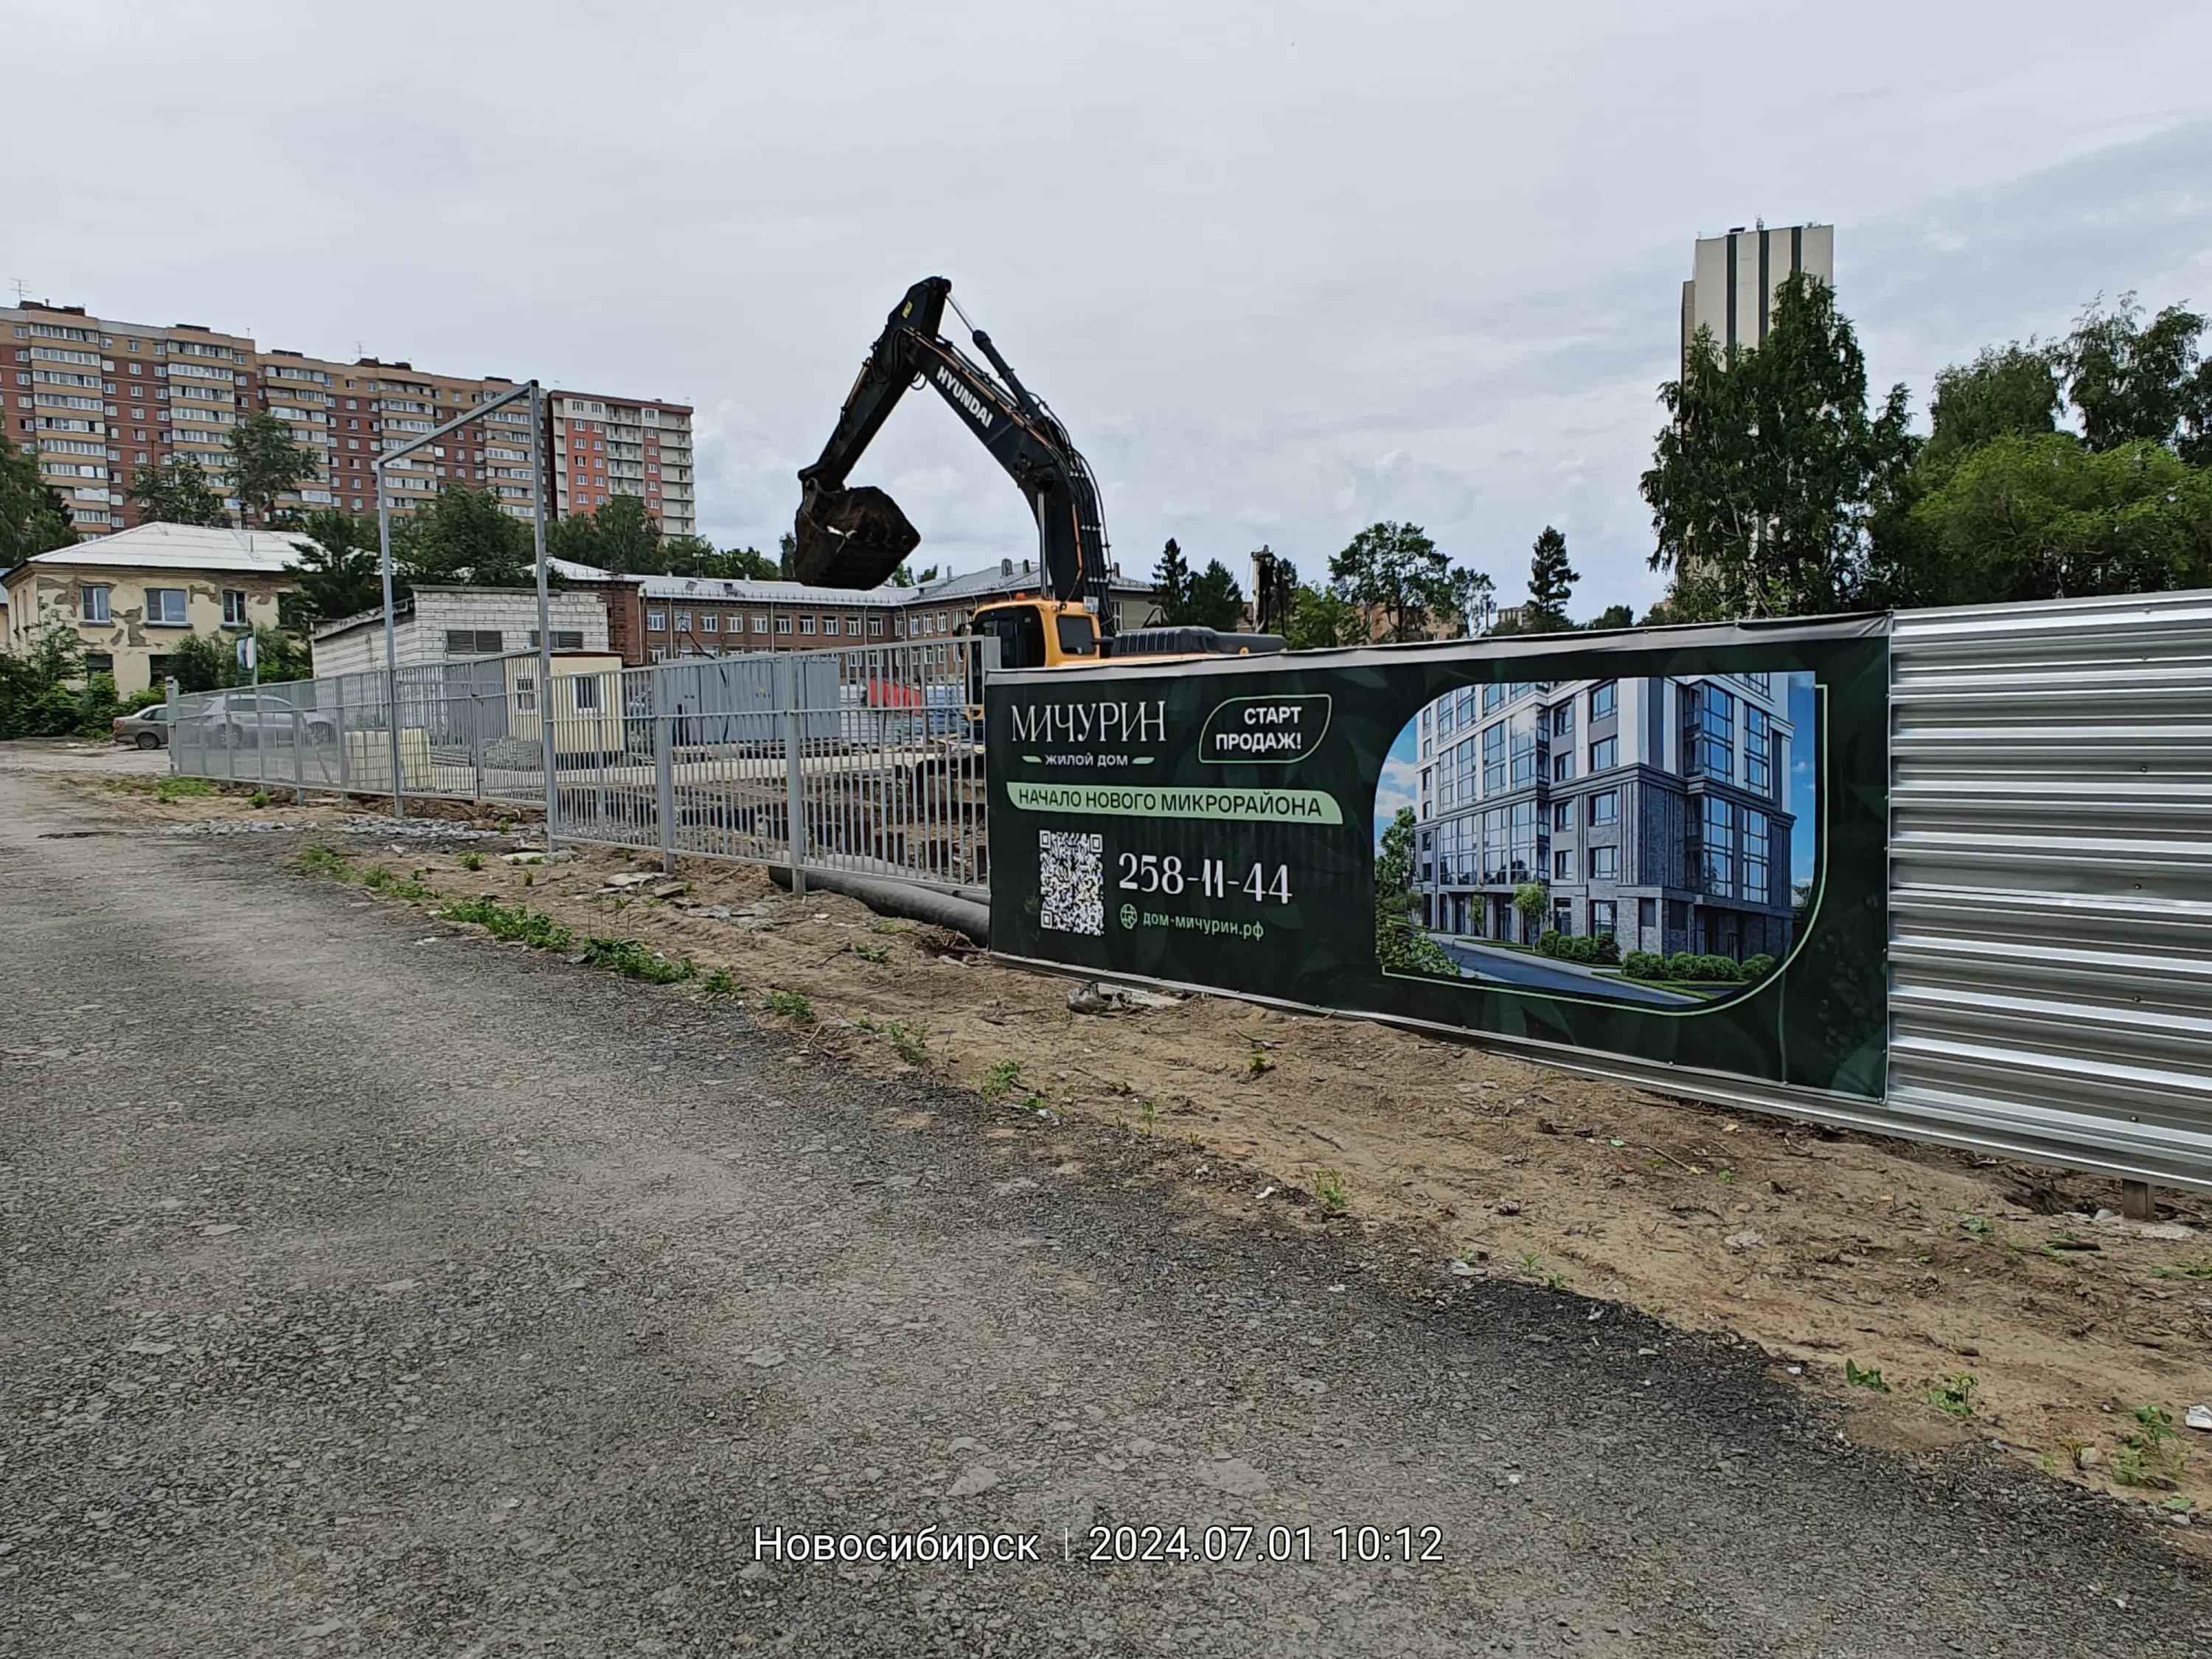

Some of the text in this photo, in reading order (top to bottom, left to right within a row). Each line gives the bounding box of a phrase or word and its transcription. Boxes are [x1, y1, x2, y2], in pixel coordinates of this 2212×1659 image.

[936, 365, 993, 428] HYUNDAI
[1011, 700, 1167, 742] МИЧУРИН
[1244, 706, 1302, 725] СТАРТ
[1216, 732, 1301, 753] ПРОДАЖ!
[1018, 788, 1323, 817] НАЧАЛО НОВОГО МИКРОРАЙОНА
[1119, 852, 1293, 905] 258-11-44
[1143, 912, 1265, 942] дом-мичурин.рф
